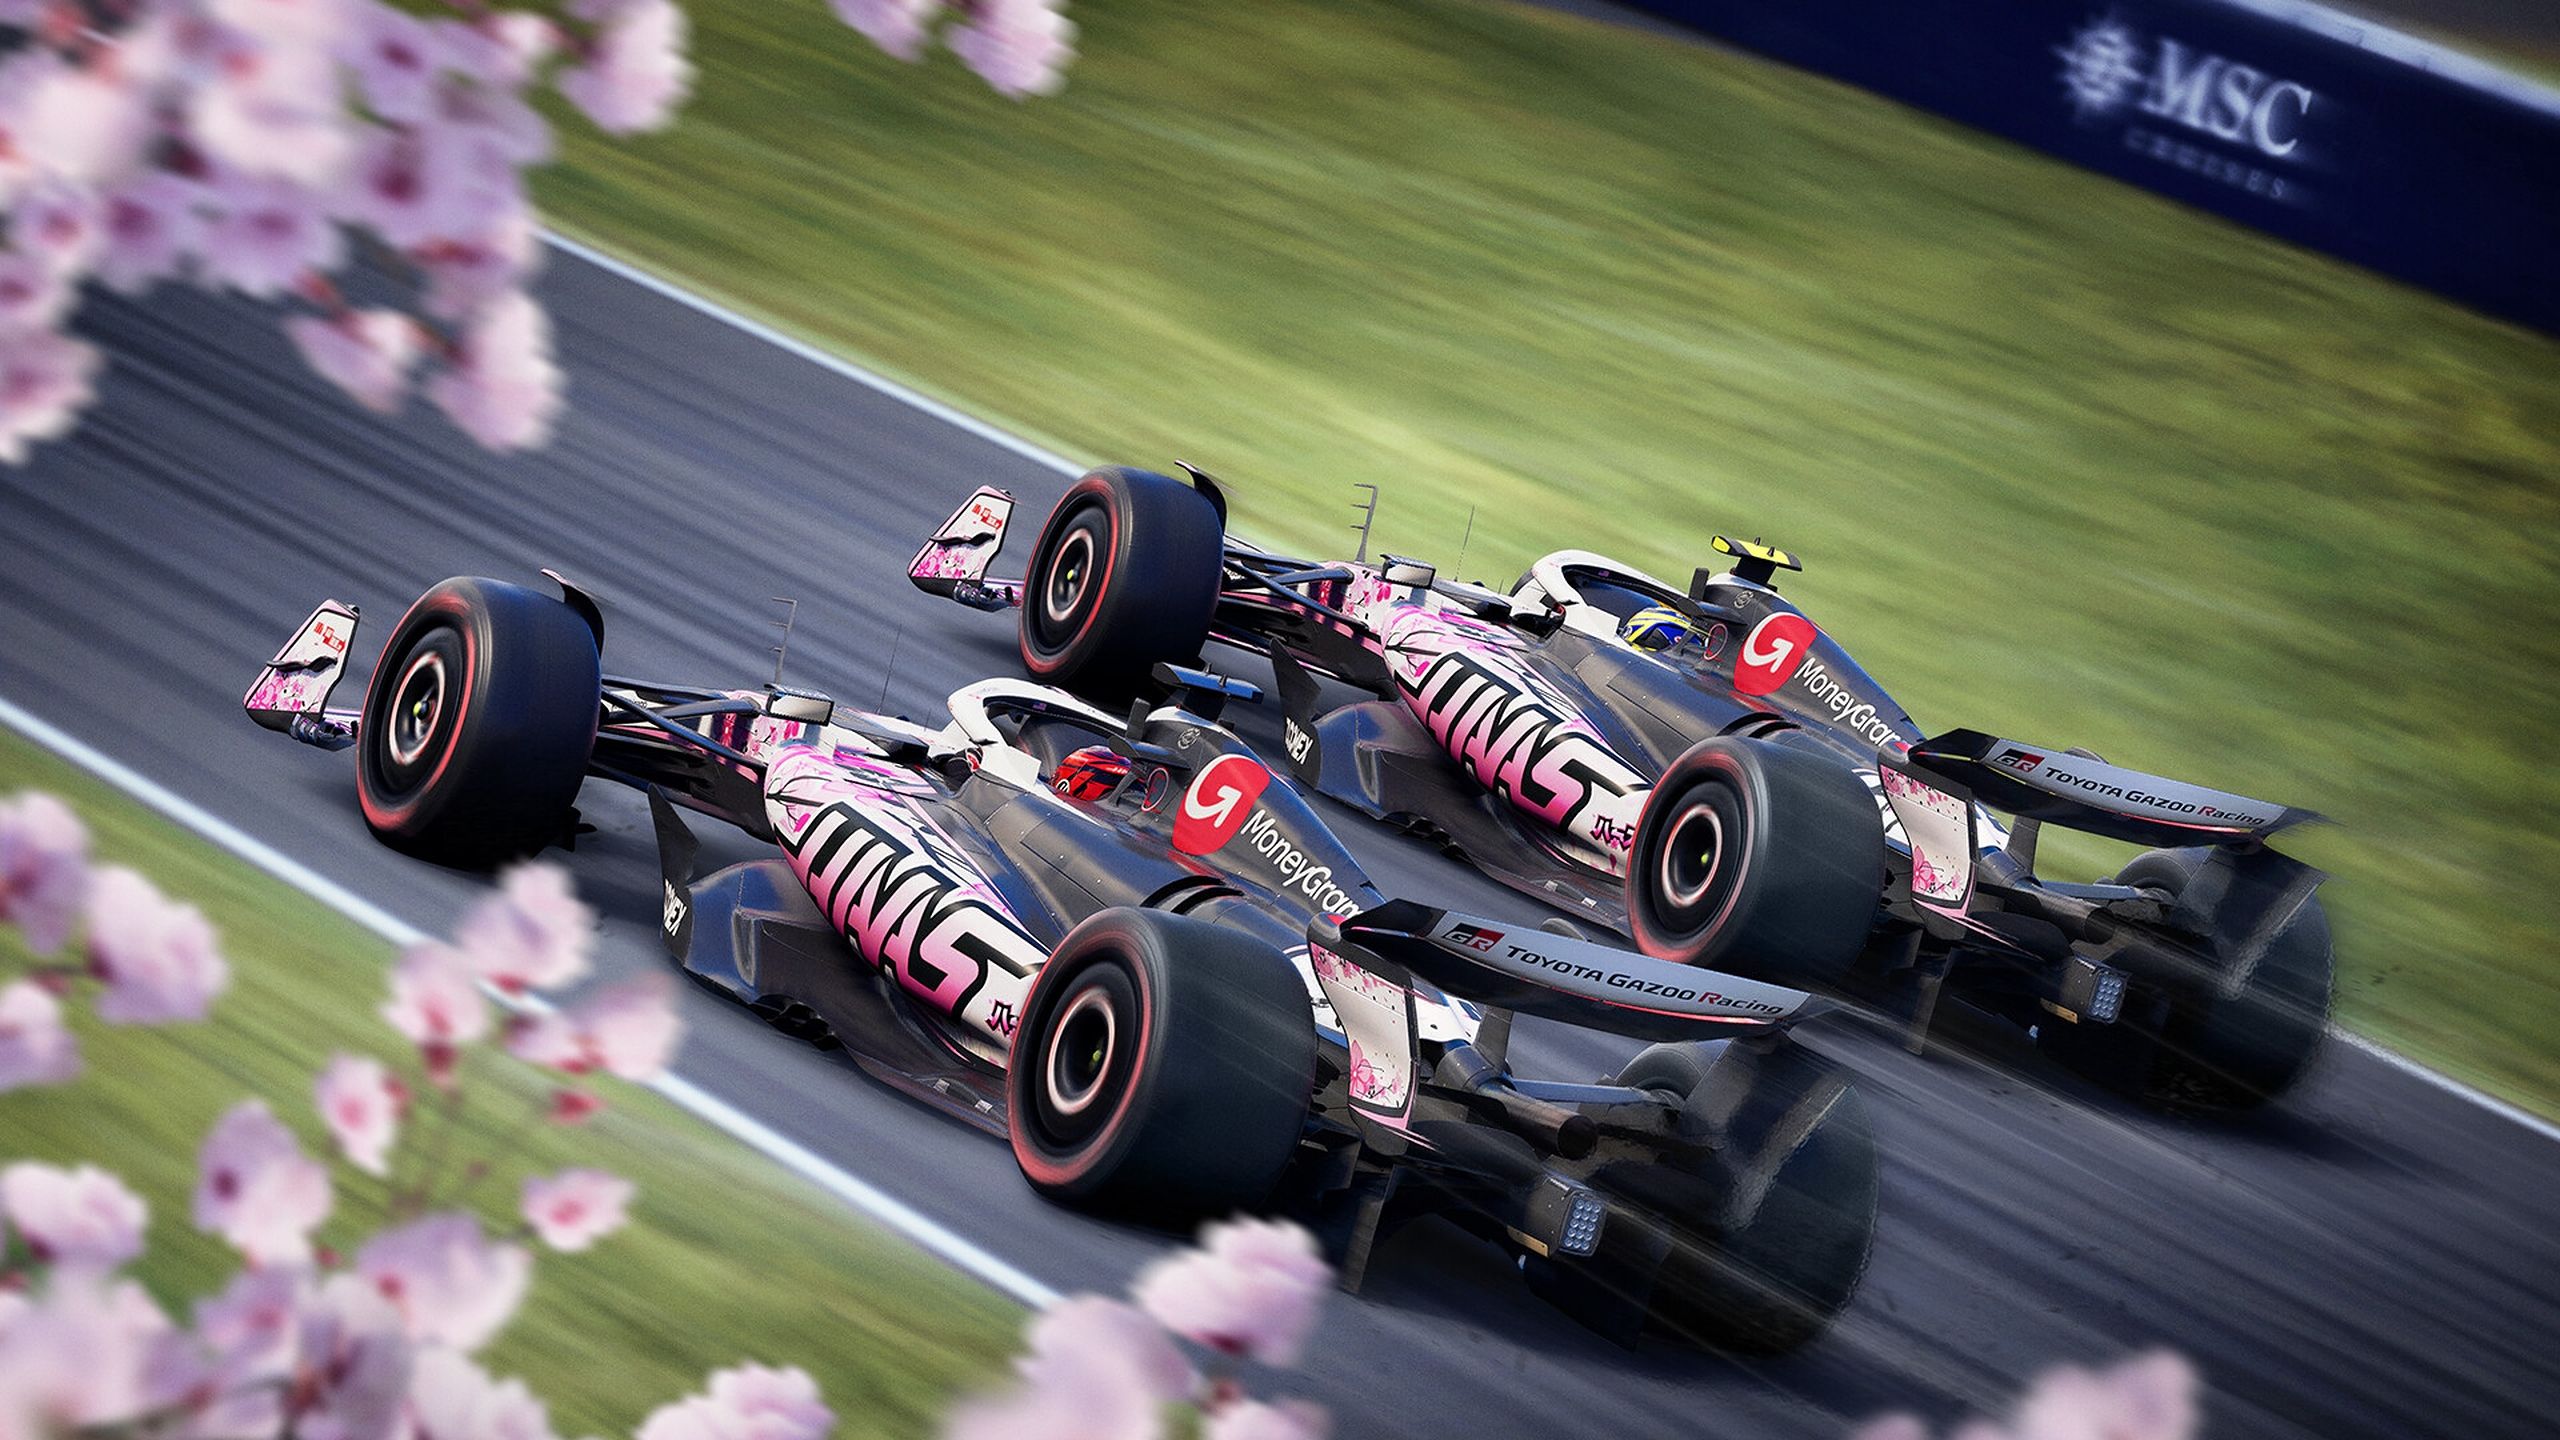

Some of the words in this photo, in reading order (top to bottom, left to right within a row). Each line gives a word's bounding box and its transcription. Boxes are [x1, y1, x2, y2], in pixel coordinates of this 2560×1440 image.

[2138, 37, 2312, 156] MSC
[1995, 752, 2039, 773] GR
[2045, 766, 2123, 798] TOYOTA
[2125, 790, 2196, 814] GAZOO
[2197, 805, 2265, 826] Racing
[1444, 930, 1500, 952] GR
[1507, 945, 1604, 983] TOYOTA
[1606, 973, 1696, 1000] GAZOO
[1699, 991, 1783, 1015] Racing
